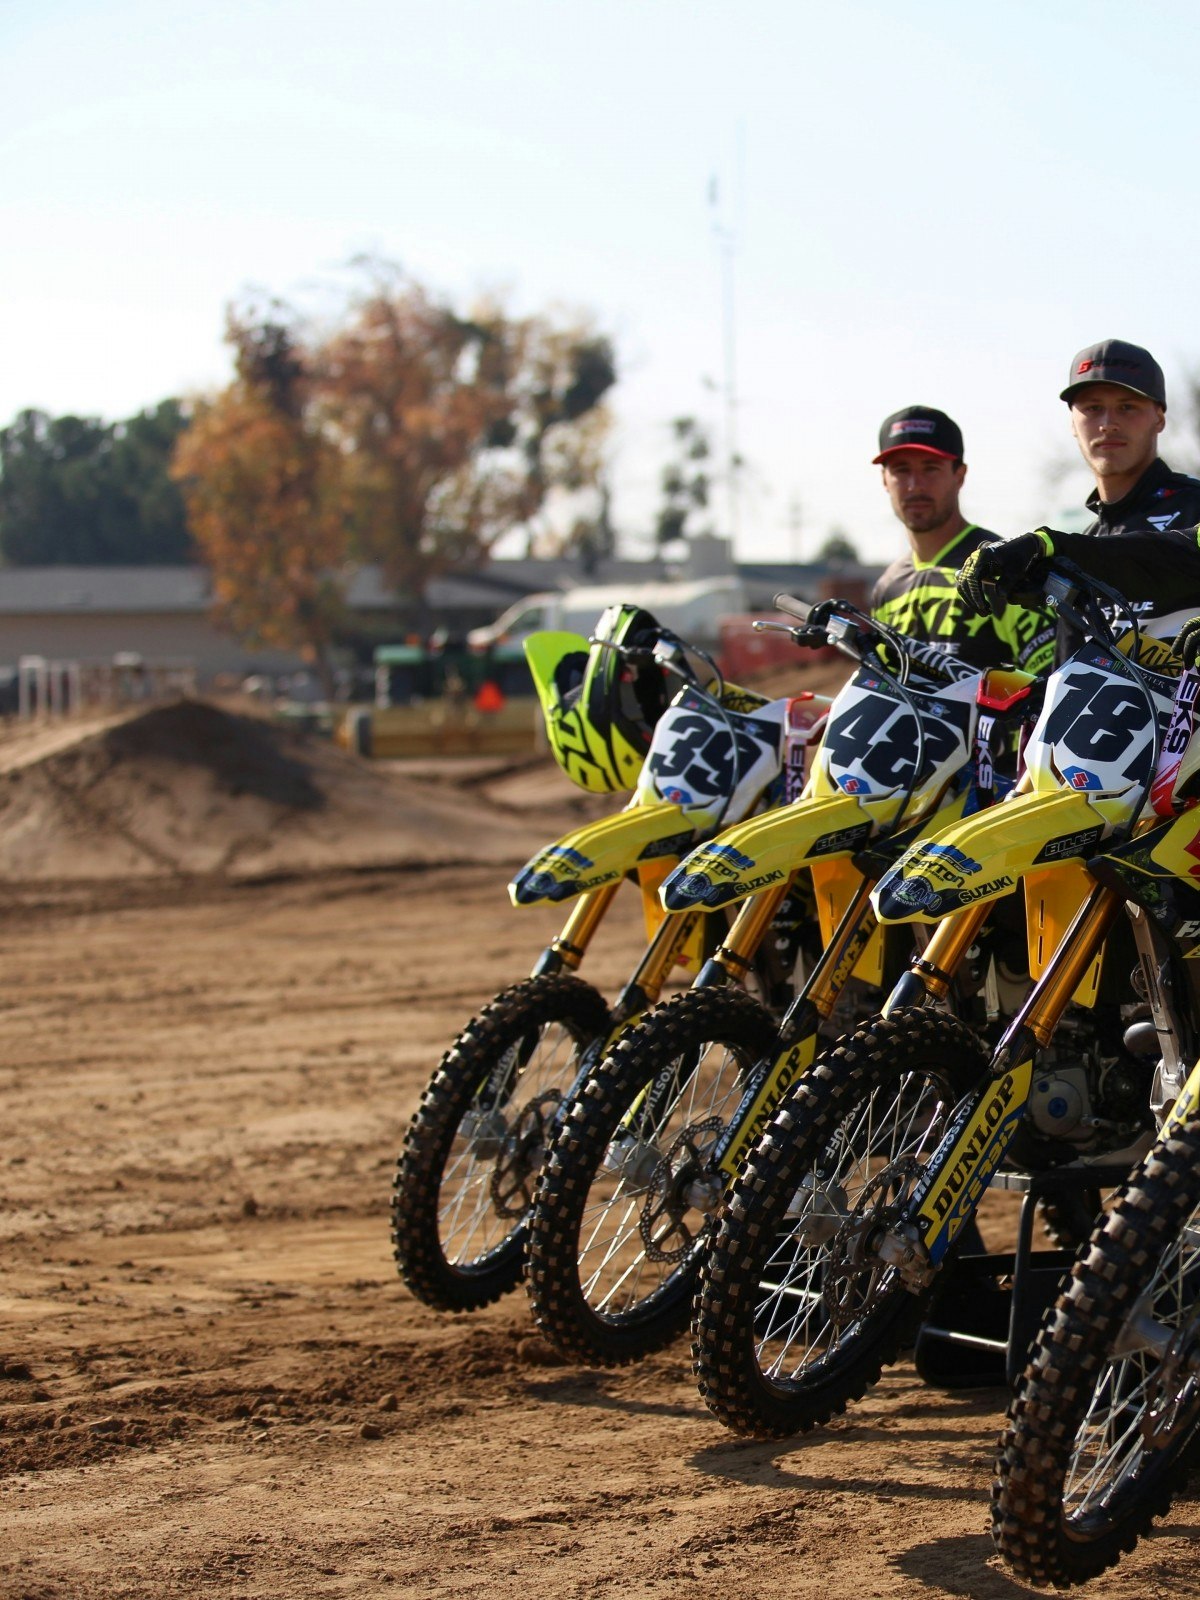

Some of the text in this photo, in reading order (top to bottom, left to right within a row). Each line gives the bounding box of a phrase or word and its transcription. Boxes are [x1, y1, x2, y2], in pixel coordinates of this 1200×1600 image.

[1018, 628, 1056, 664] FACTOR
[823, 694, 961, 791] 48
[977, 715, 995, 790] EKS
[1038, 672, 1155, 763] 18
[649, 715, 762, 797] 39
[1045, 831, 1098, 857] BILL'S
[734, 869, 785, 895] SUZUKI
[959, 875, 1014, 904] SUZUKI
[932, 1074, 1015, 1222] DUNLOP
